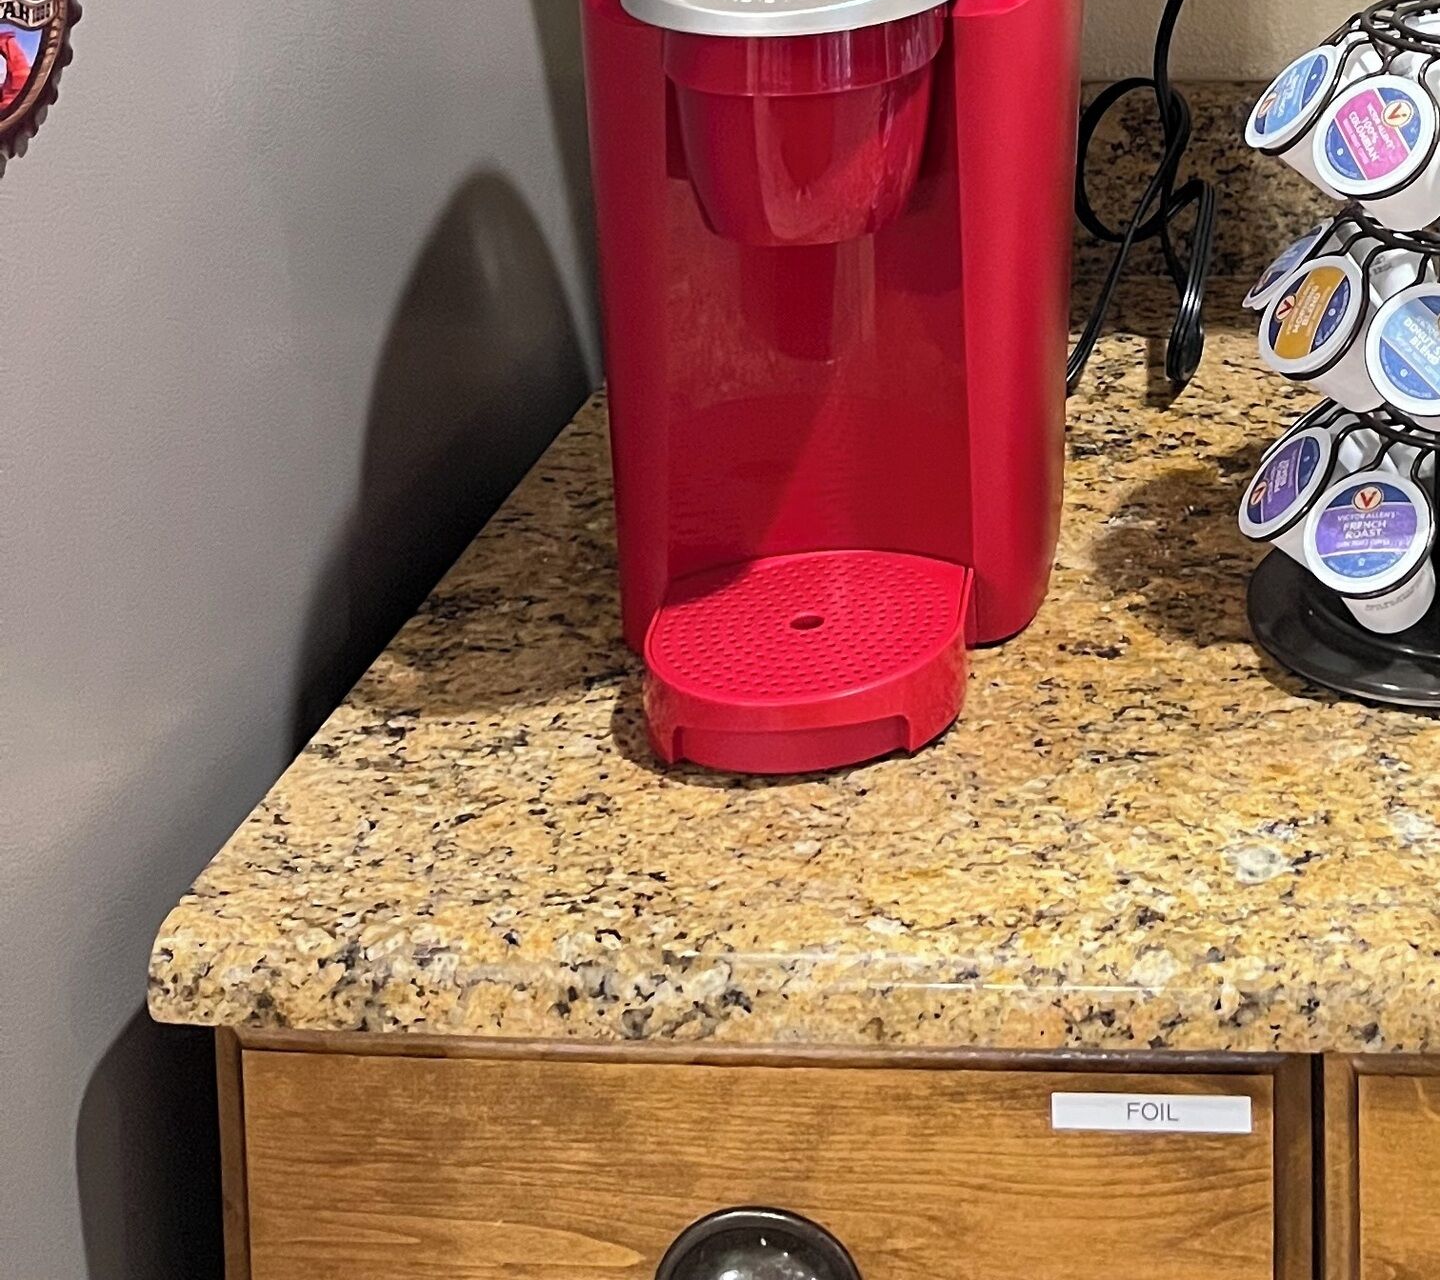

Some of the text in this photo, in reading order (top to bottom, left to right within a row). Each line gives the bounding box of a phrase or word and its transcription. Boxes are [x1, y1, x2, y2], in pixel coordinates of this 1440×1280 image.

[1346, 110, 1380, 162] COLOMBIAN
[1360, 115, 1380, 144] 100%
[1401, 316, 1436, 348] DONUT
[1407, 335, 1440, 366] BLEND
[1337, 513, 1365, 522] VICTOR
[1342, 519, 1386, 531] FRENCH
[1344, 528, 1382, 539] ROAST
[1127, 1102, 1179, 1122] FOIL
